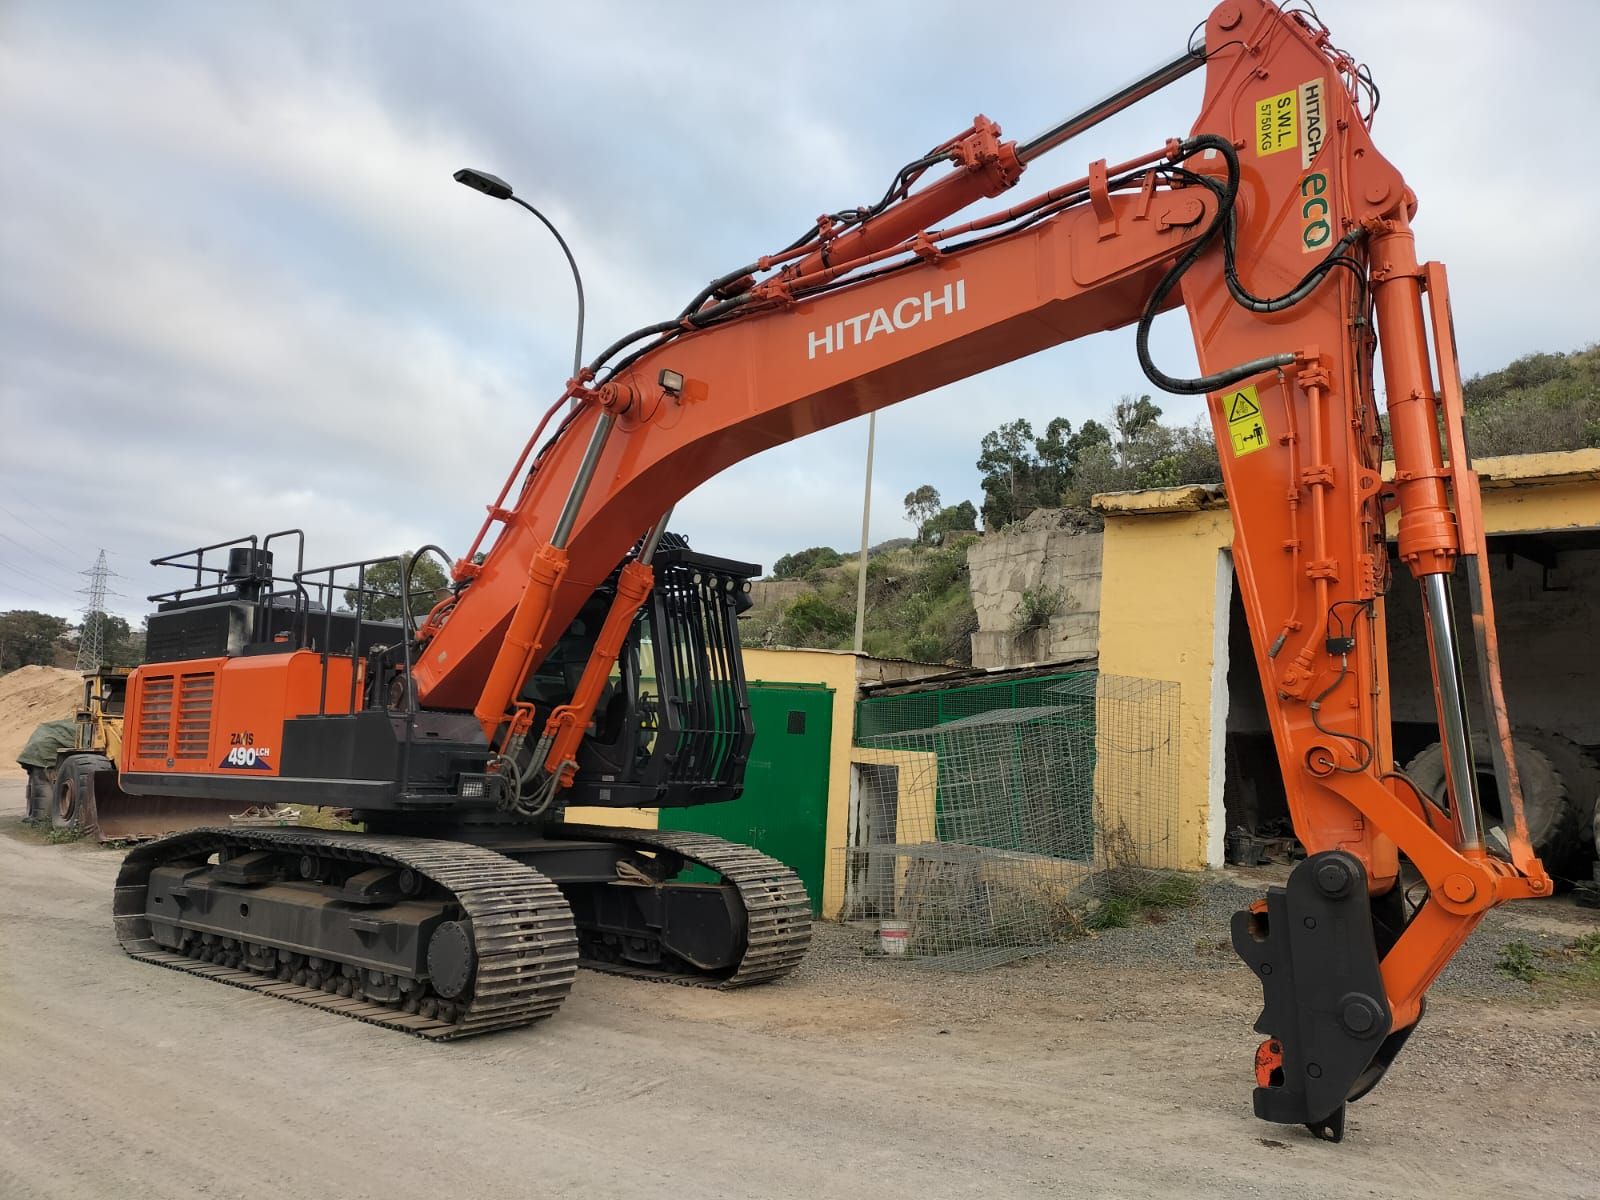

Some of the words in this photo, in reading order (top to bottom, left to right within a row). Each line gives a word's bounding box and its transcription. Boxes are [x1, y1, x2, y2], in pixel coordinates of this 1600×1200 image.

[1277, 97, 1292, 147] S.W.L.
[808, 279, 966, 360] HITACHI
[228, 747, 256, 766] 490
